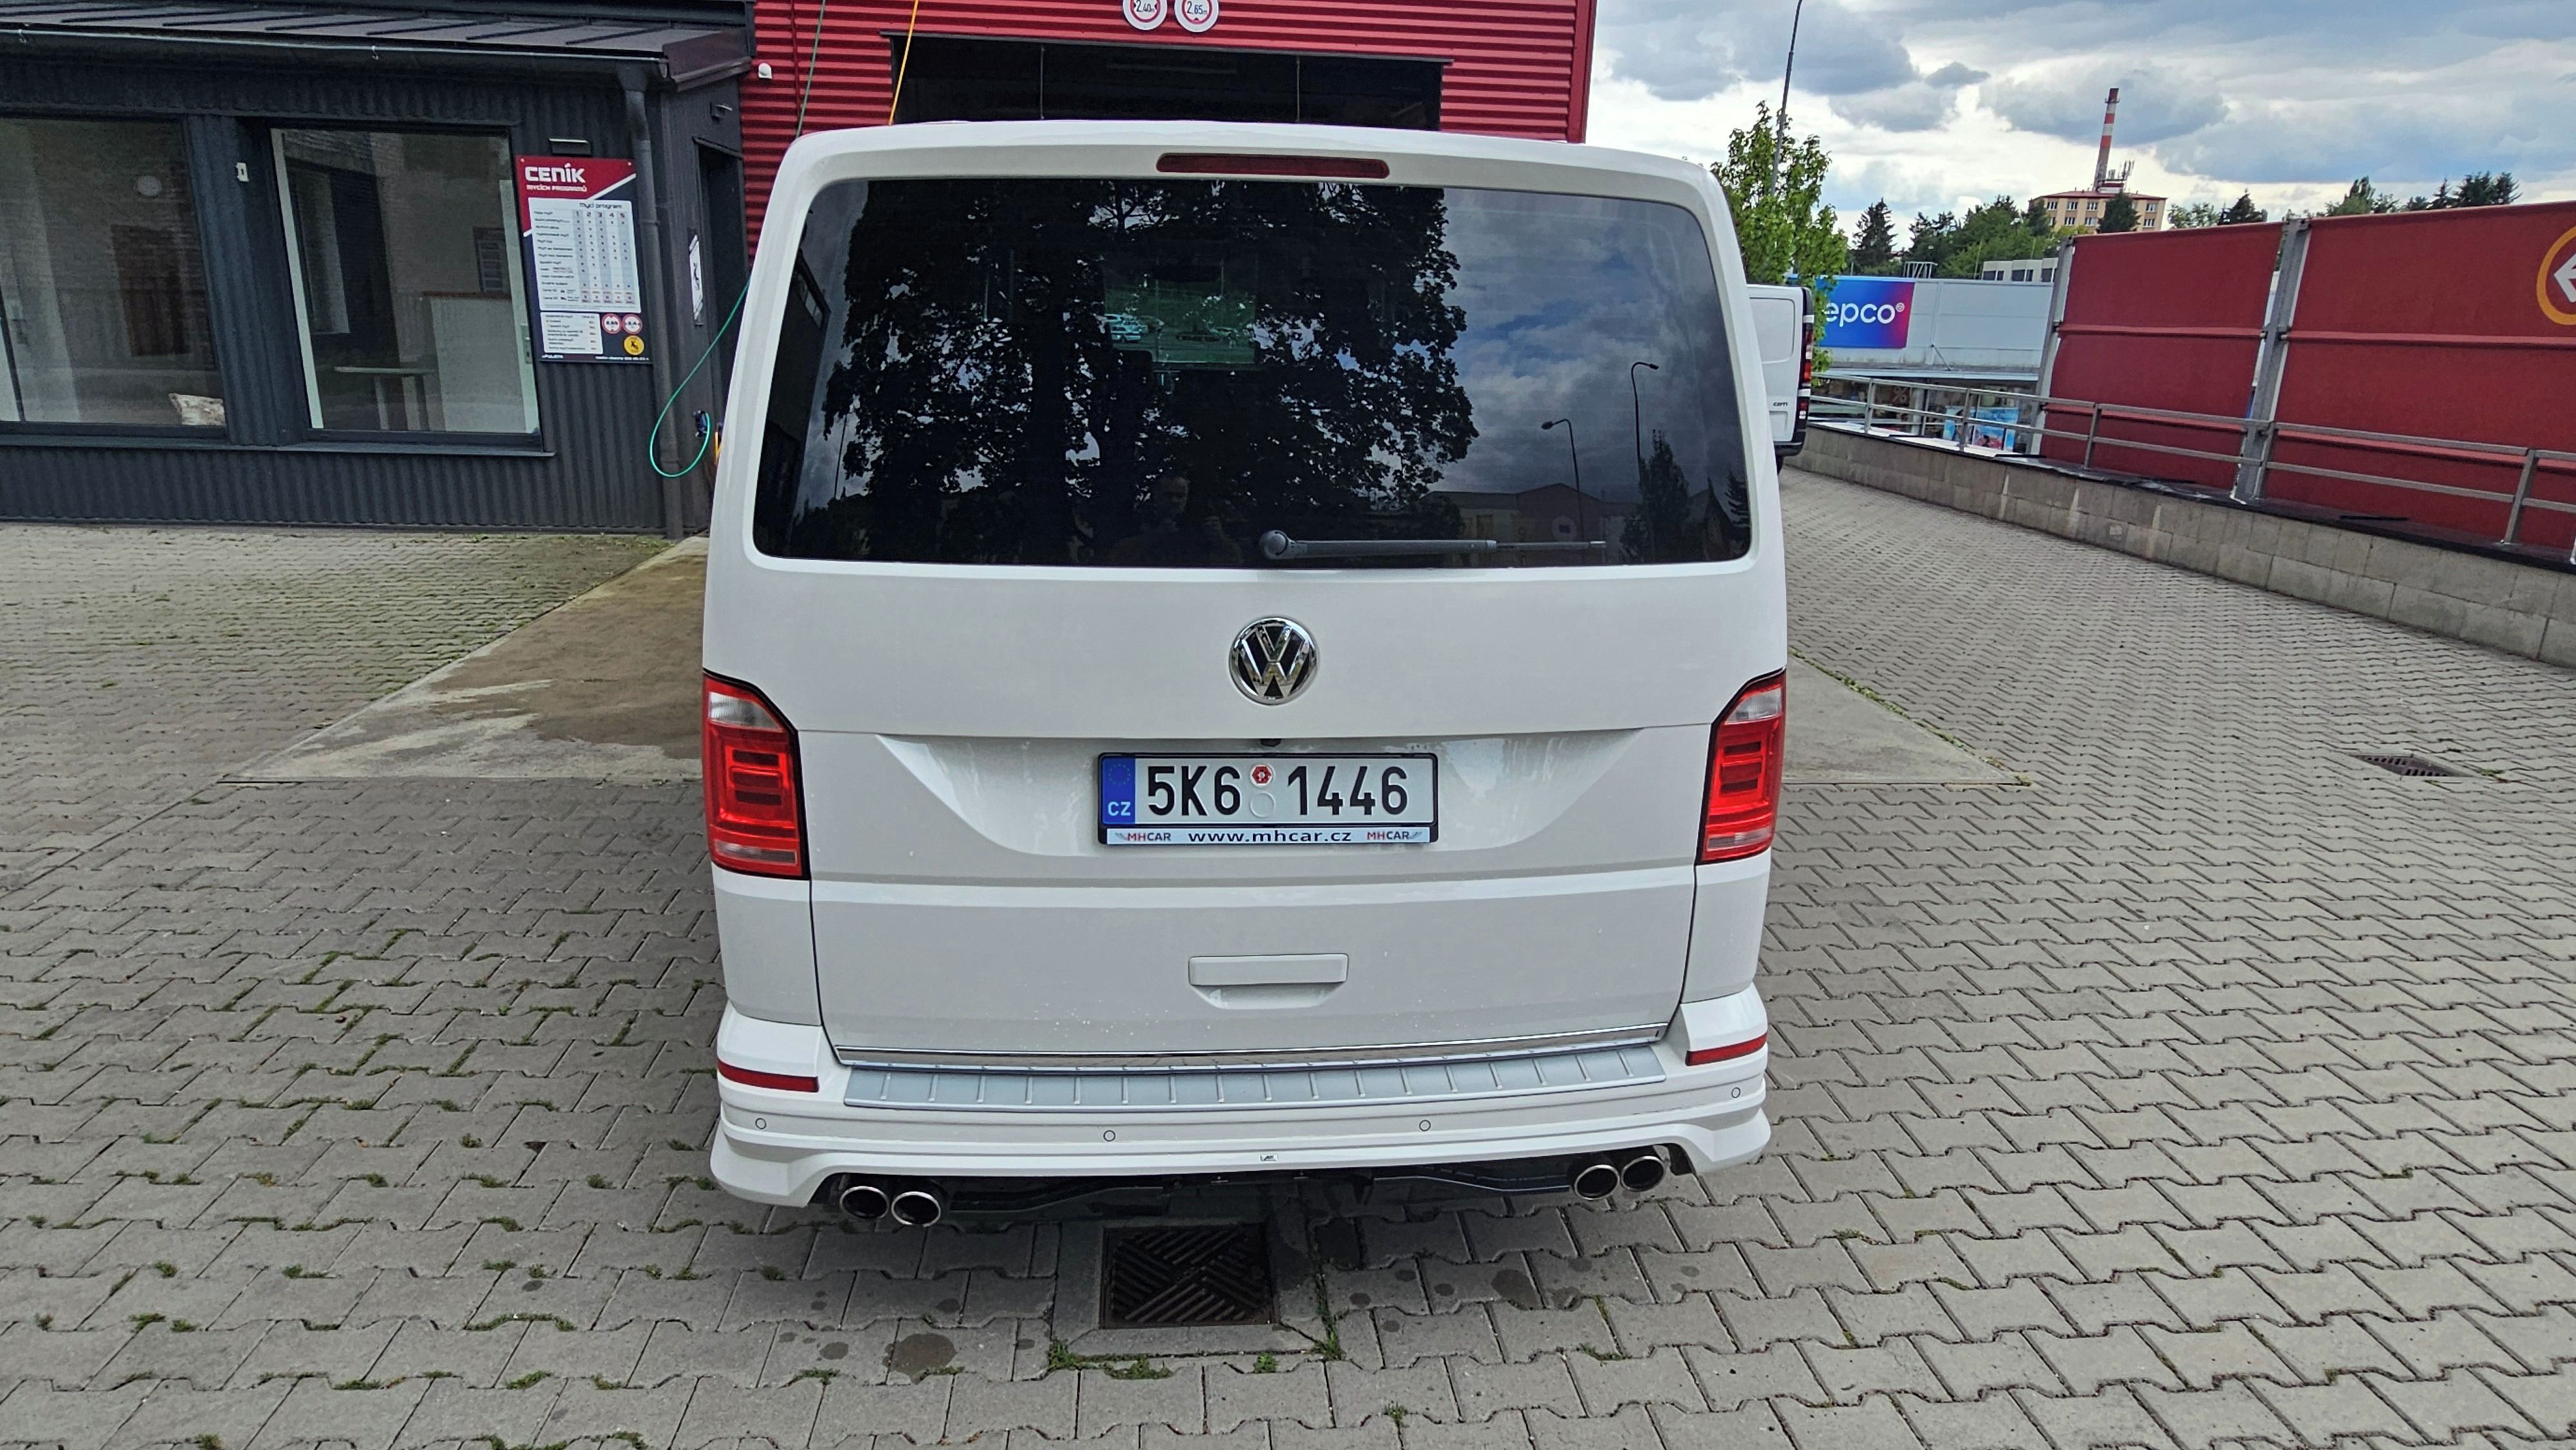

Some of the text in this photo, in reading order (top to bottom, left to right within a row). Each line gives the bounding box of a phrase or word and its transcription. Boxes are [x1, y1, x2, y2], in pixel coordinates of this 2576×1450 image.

[1824, 302, 1895, 327] epco
[1148, 766, 1408, 816] 5K6 1446
[1108, 801, 1131, 816] CZ
[1128, 833, 1171, 842] MHCAR
[1188, 830, 1352, 842] www.mhcar.cz
[1367, 831, 1410, 840] MHCAR
